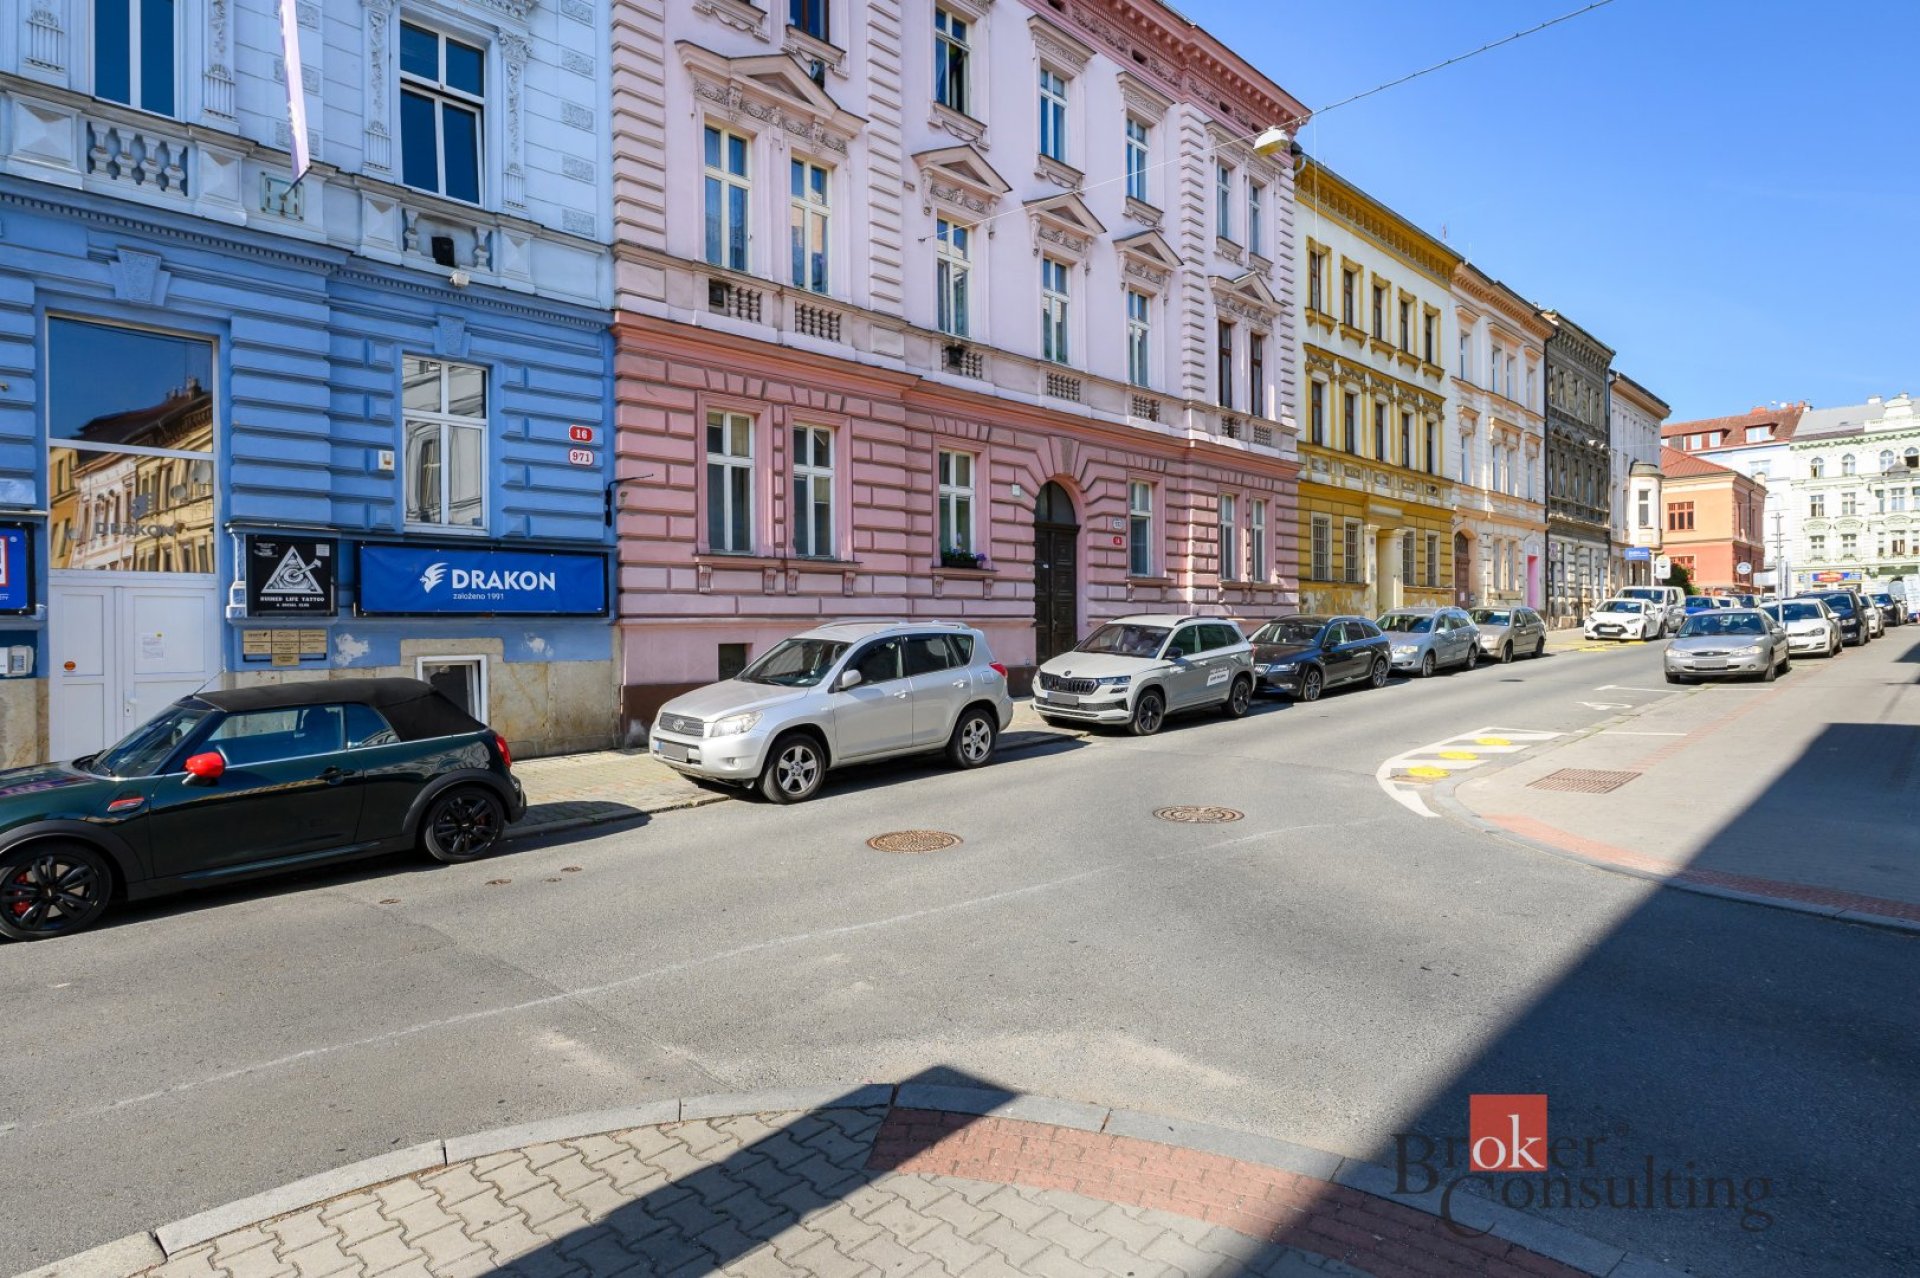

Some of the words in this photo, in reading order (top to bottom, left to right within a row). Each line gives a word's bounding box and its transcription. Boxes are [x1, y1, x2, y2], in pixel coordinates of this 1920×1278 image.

[575, 430, 588, 440] 16
[572, 451, 590, 462] 971
[95, 522, 176, 537] DRAKON
[452, 569, 556, 591] DRAKON
[453, 592, 486, 600] založeno
[487, 592, 504, 600] 1991
